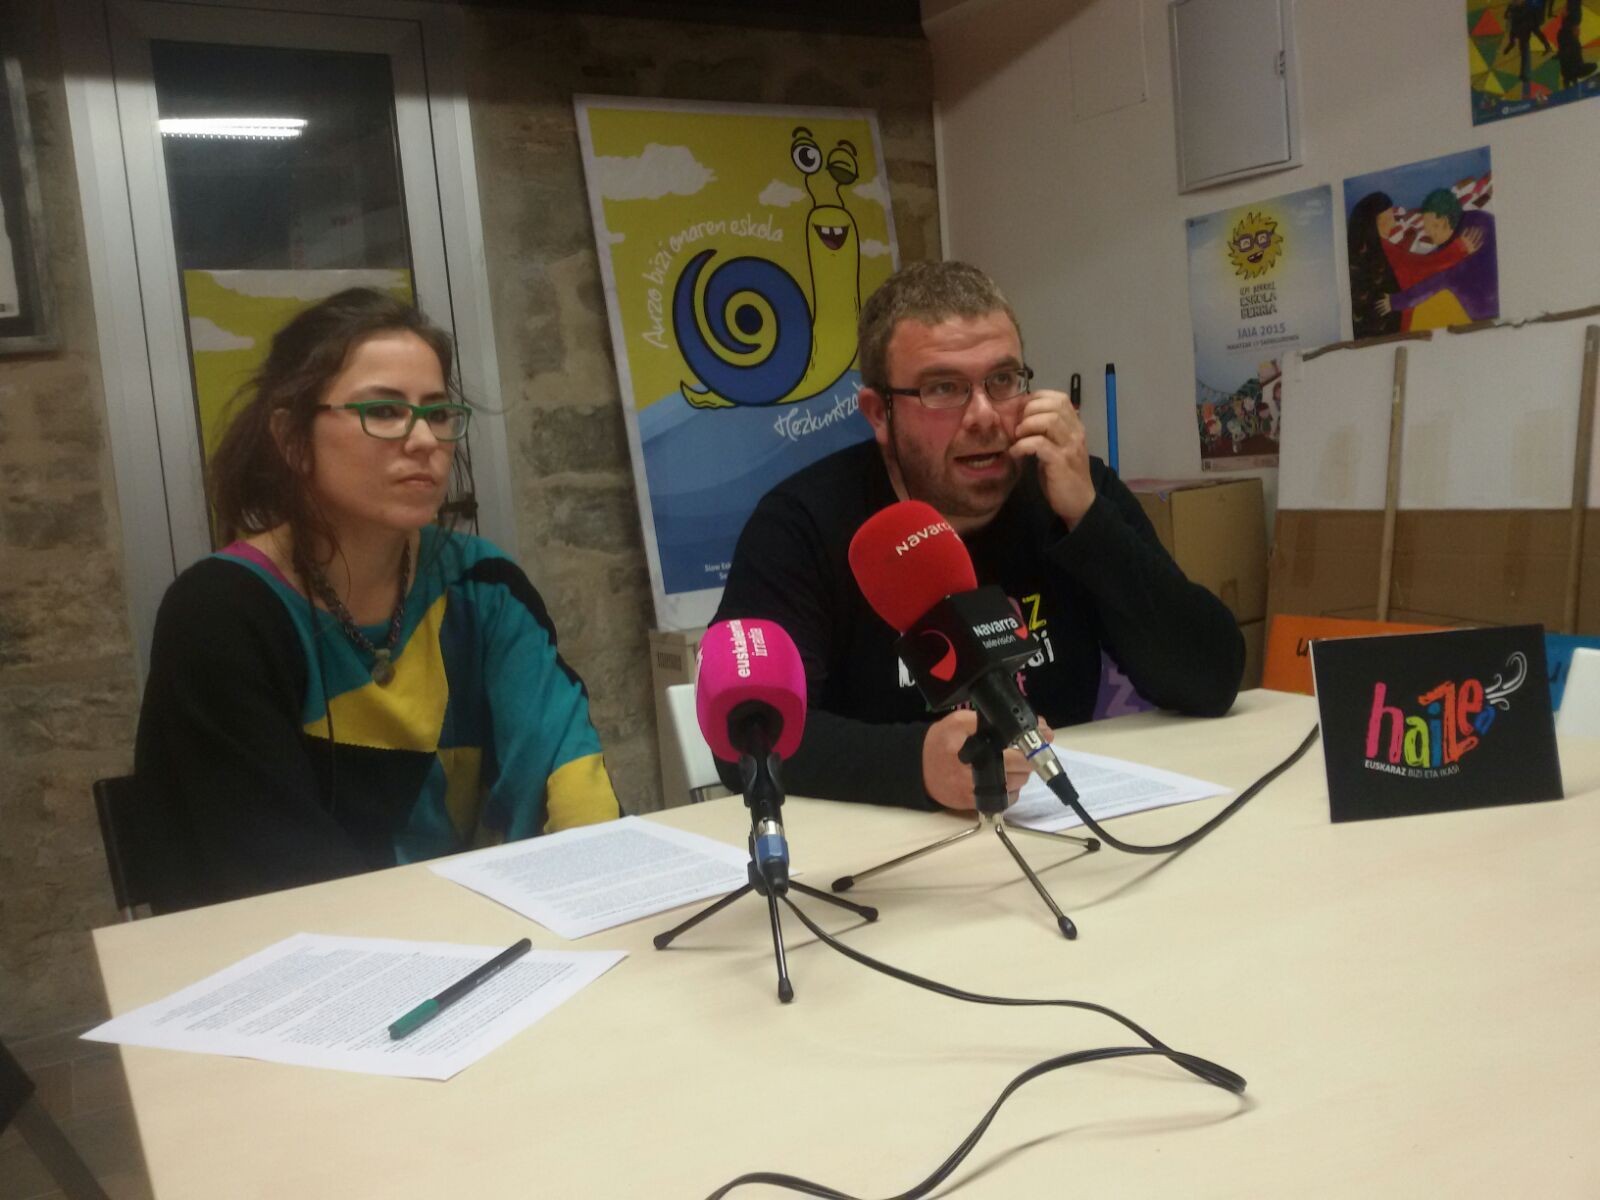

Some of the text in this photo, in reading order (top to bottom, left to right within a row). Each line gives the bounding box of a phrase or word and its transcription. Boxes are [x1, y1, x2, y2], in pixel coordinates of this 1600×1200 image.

[641, 241, 673, 285] bizi
[669, 219, 727, 254] onaren
[730, 213, 783, 242] eskola
[1260, 322, 1286, 336] 2015
[972, 617, 1018, 637] Navarra
[1364, 759, 1407, 777] EUSKARAZ
[1407, 768, 1423, 779] BIZI
[1424, 769, 1439, 779] ETA
